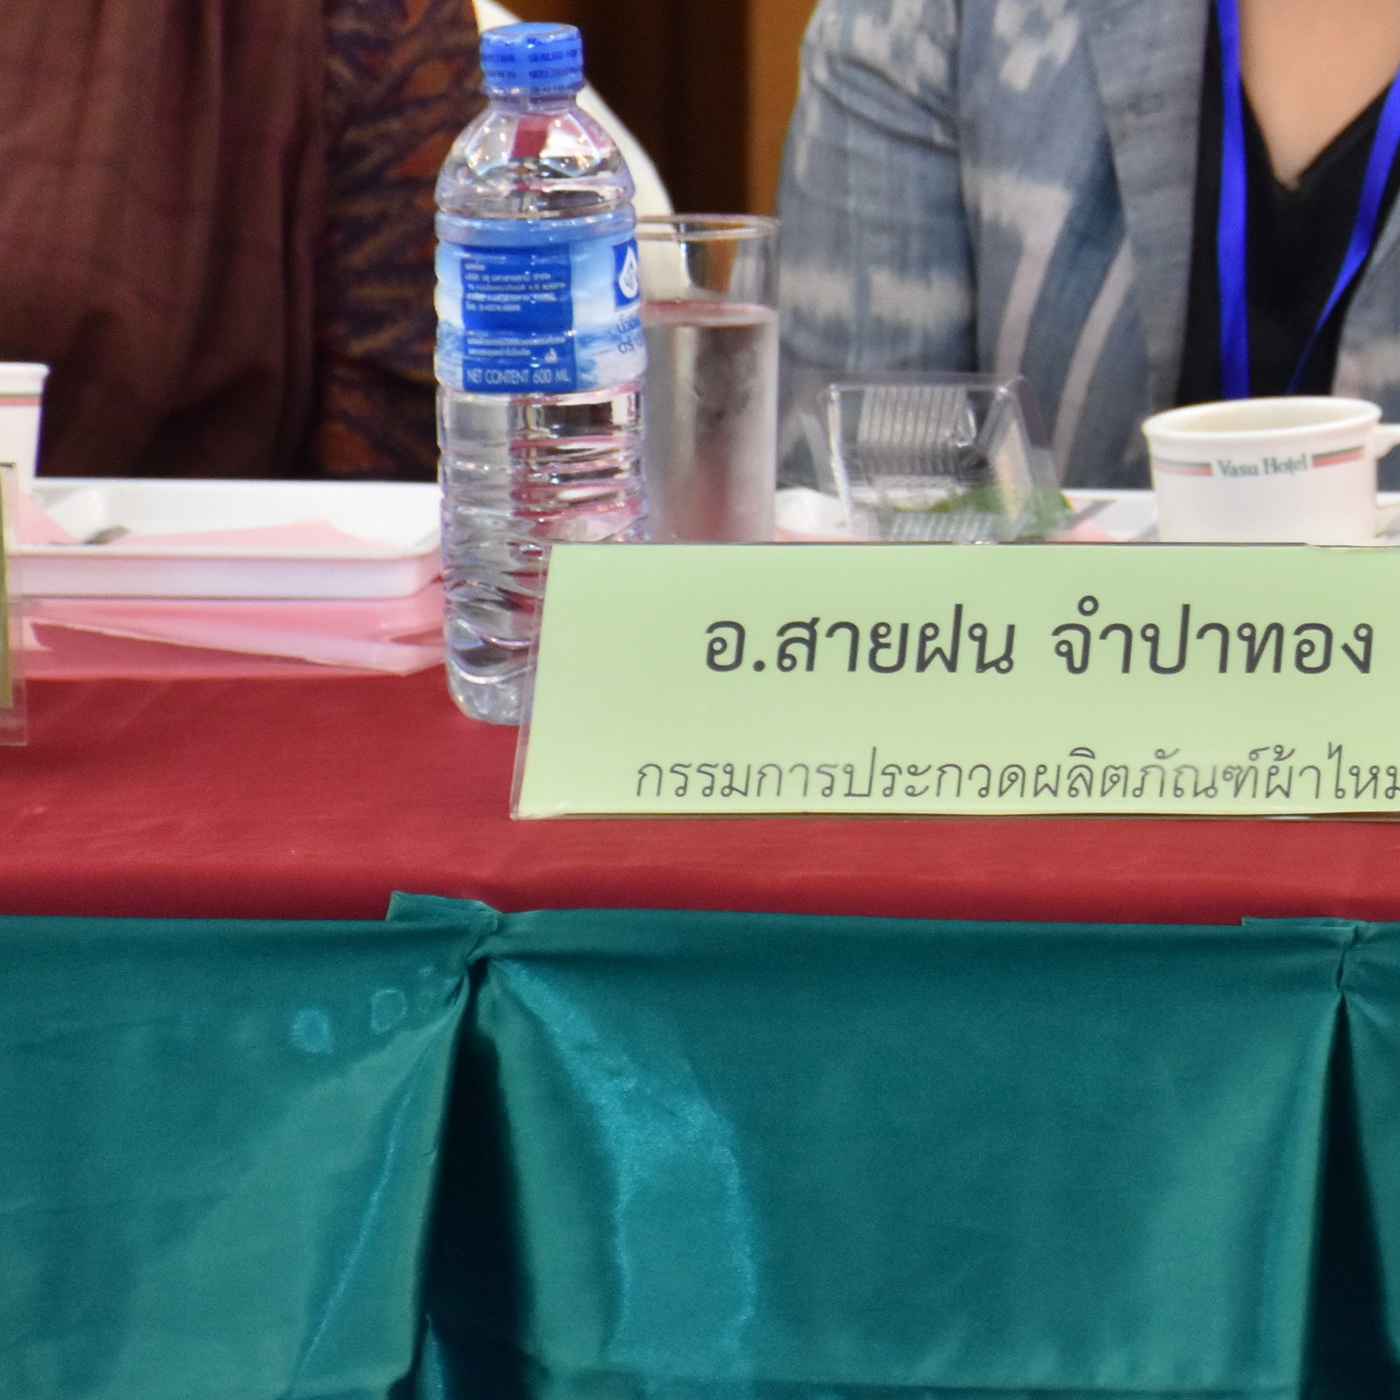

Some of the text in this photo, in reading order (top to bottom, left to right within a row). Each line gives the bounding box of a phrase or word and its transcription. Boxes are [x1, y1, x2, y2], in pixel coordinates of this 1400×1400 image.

[484, 368, 529, 385] CONTENT
[532, 368, 552, 384] 600
[1216, 453, 1308, 476] Vasu Hotel
[705, 595, 1374, 676] อ.สายฝน จำปาทอง
